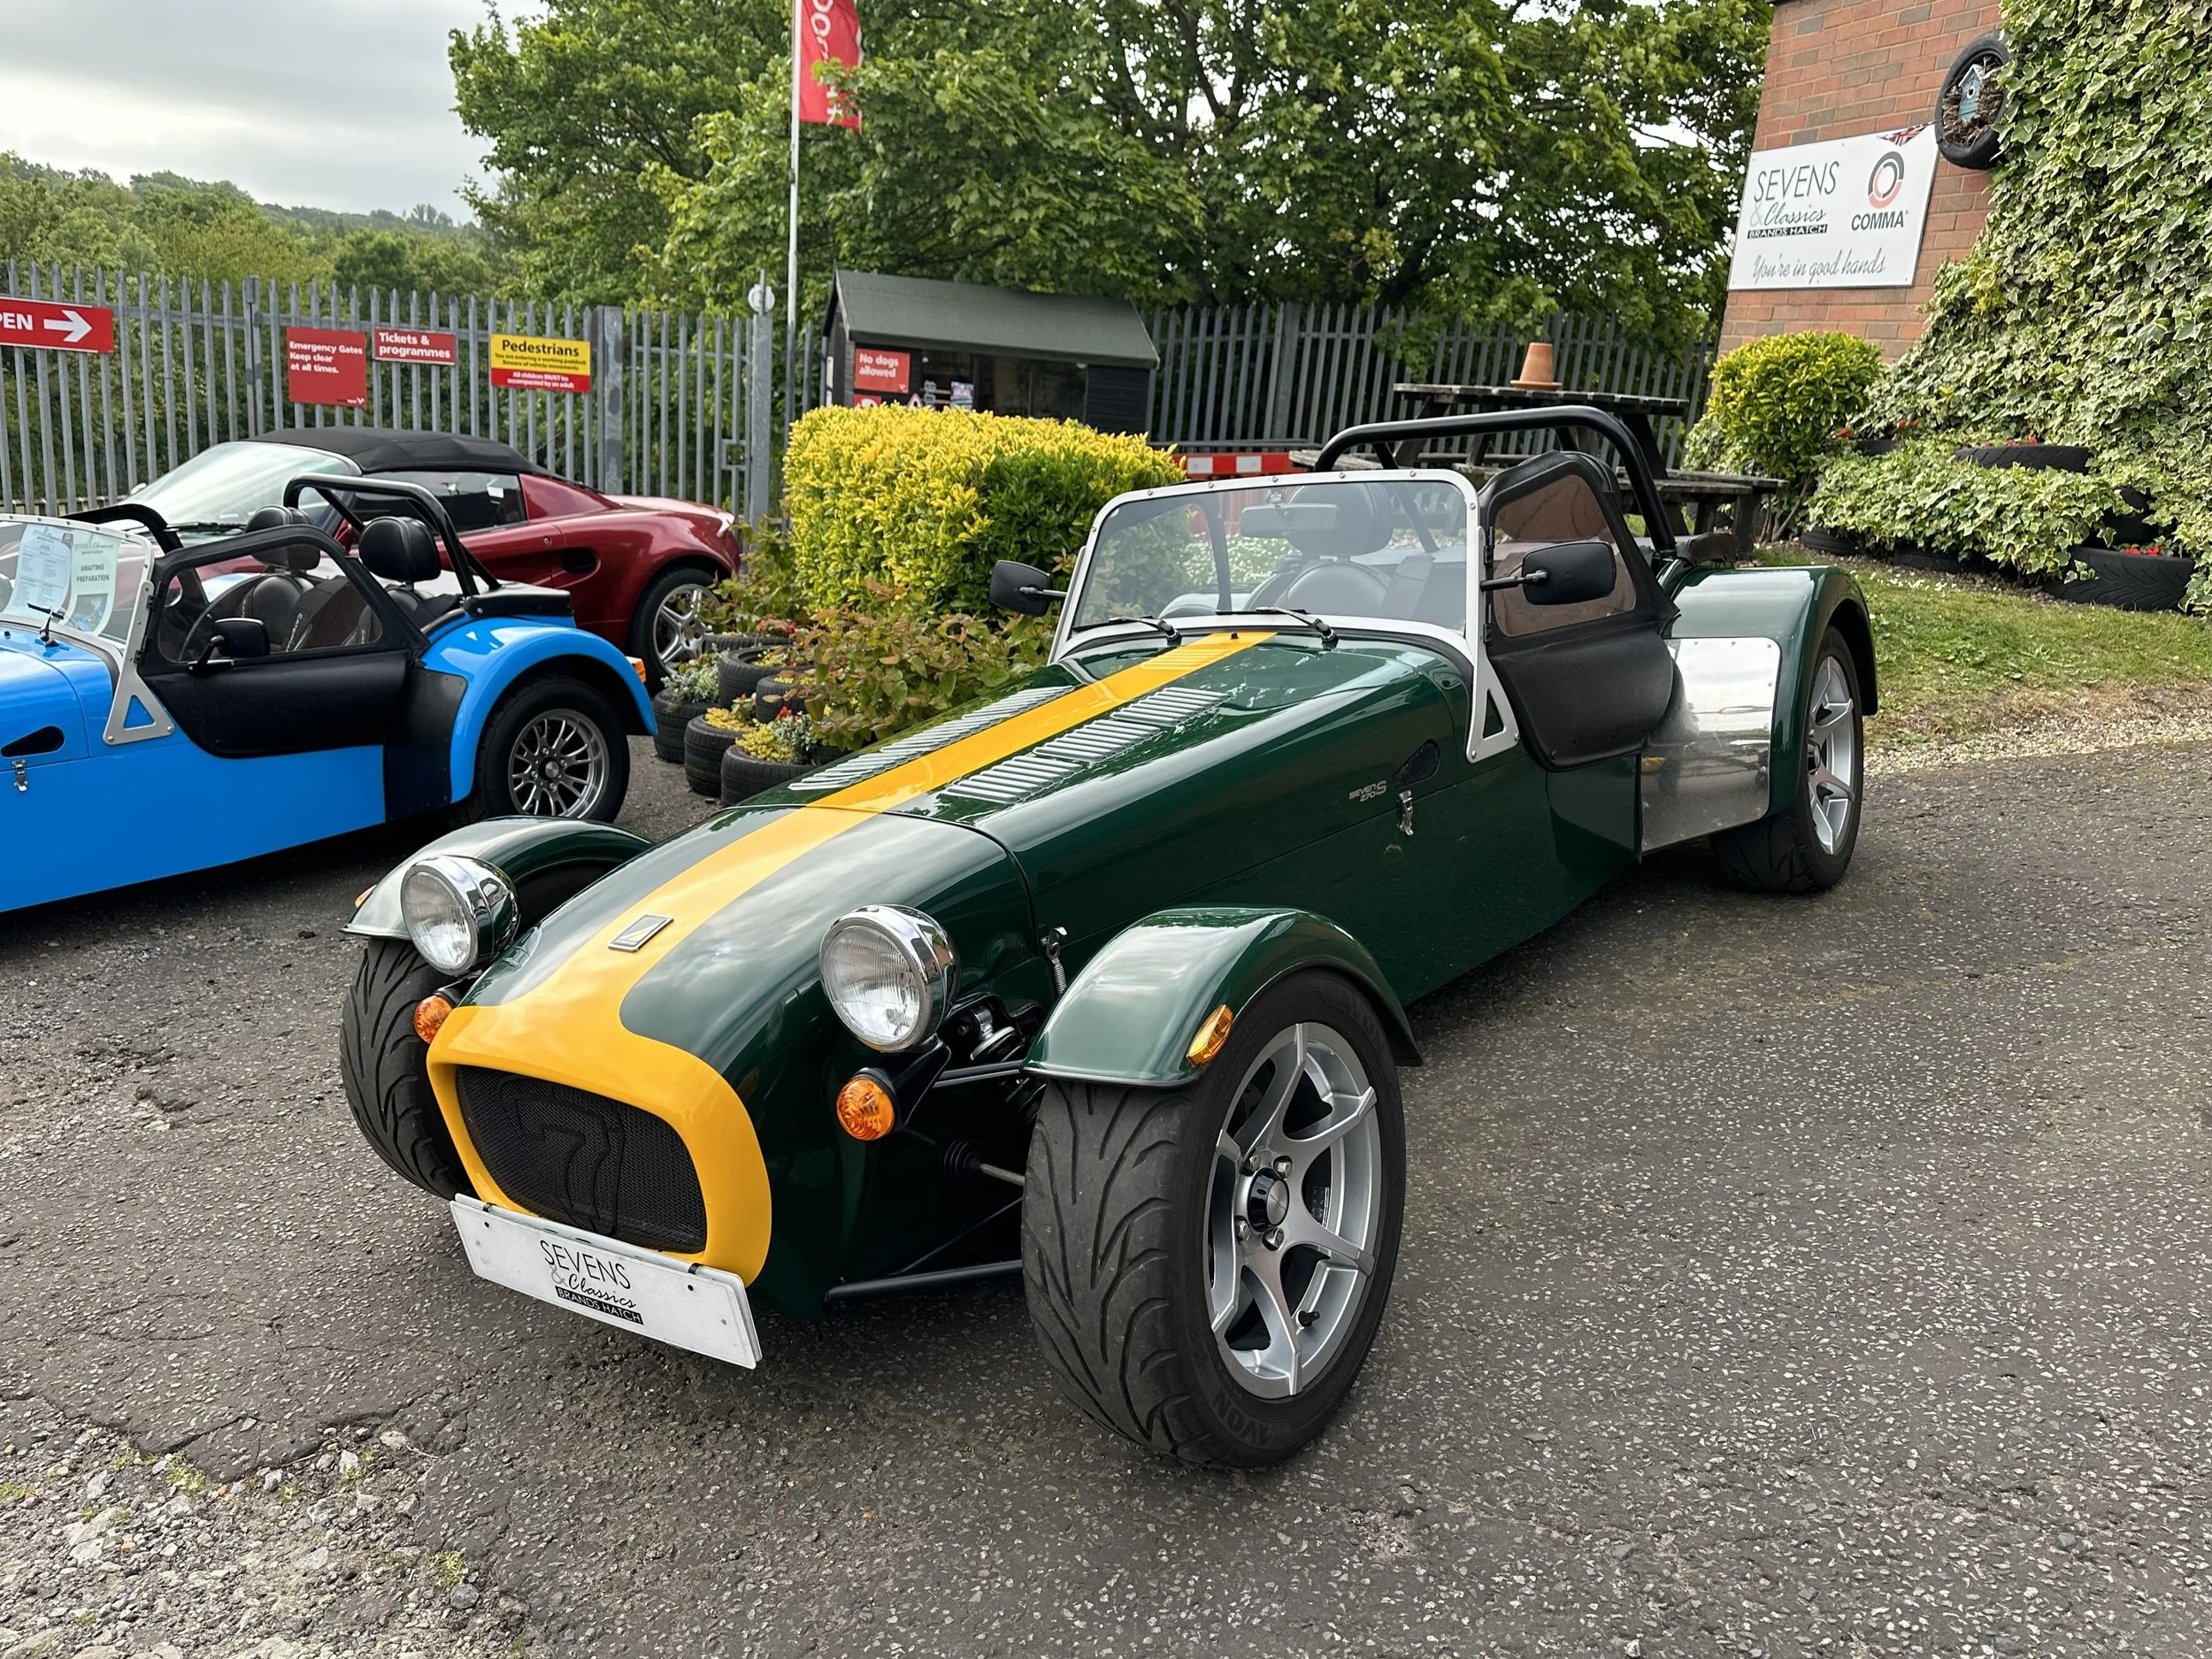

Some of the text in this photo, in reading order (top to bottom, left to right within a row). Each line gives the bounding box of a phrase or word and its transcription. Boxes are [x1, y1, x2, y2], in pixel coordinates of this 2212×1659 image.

[1754, 161, 1839, 203] SEVENS
[1764, 202, 1826, 227] Classics
[1851, 210, 1904, 231] COMMA
[1748, 225, 1827, 239] BRANDS HATCH
[1752, 247, 1886, 286] You're in good hands
[0, 311, 34, 331] EN
[379, 332, 430, 345] Tickets &
[289, 341, 363, 355] Emergency Gates
[379, 345, 451, 359] programmes
[502, 339, 580, 357] Pedestrians
[289, 351, 334, 363] Keep clear
[859, 353, 899, 368] No dogs
[302, 363, 312, 372] all
[313, 364, 340, 374] times.
[859, 365, 896, 378] allowed
[81, 563, 105, 572] AWAITING
[76, 574, 110, 583] PREPARATION
[1360, 791, 1376, 803] 270
[540, 1240, 631, 1290] SEVENS
[549, 1263, 636, 1309] & Classics
[557, 1287, 642, 1325] BRANDS HATCH
